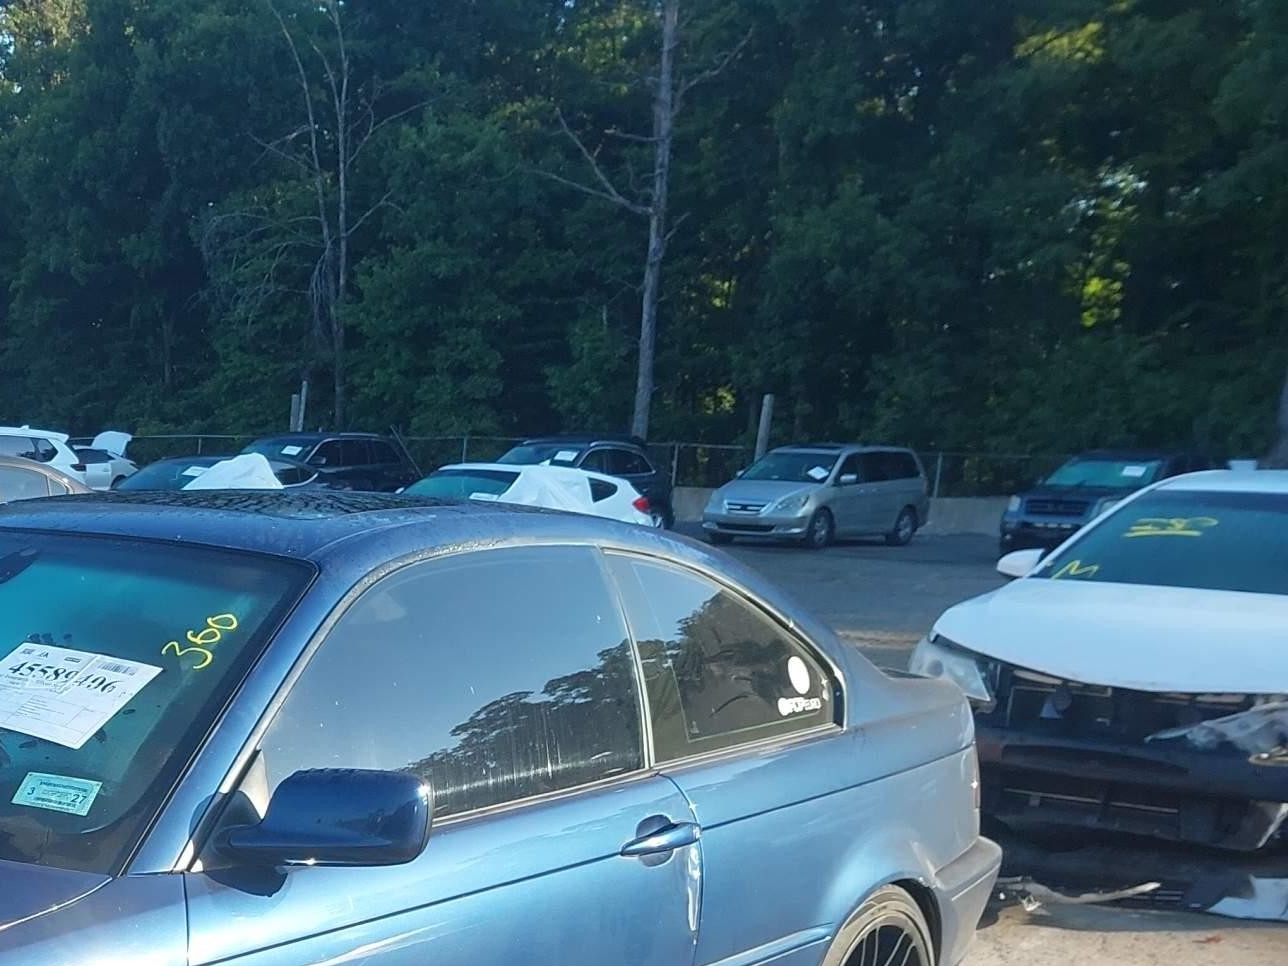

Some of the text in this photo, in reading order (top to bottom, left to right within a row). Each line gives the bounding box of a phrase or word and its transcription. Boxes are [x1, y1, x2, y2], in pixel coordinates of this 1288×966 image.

[161, 613, 238, 669] 360
[27, 786, 36, 796] 3
[70, 793, 87, 805] 27
